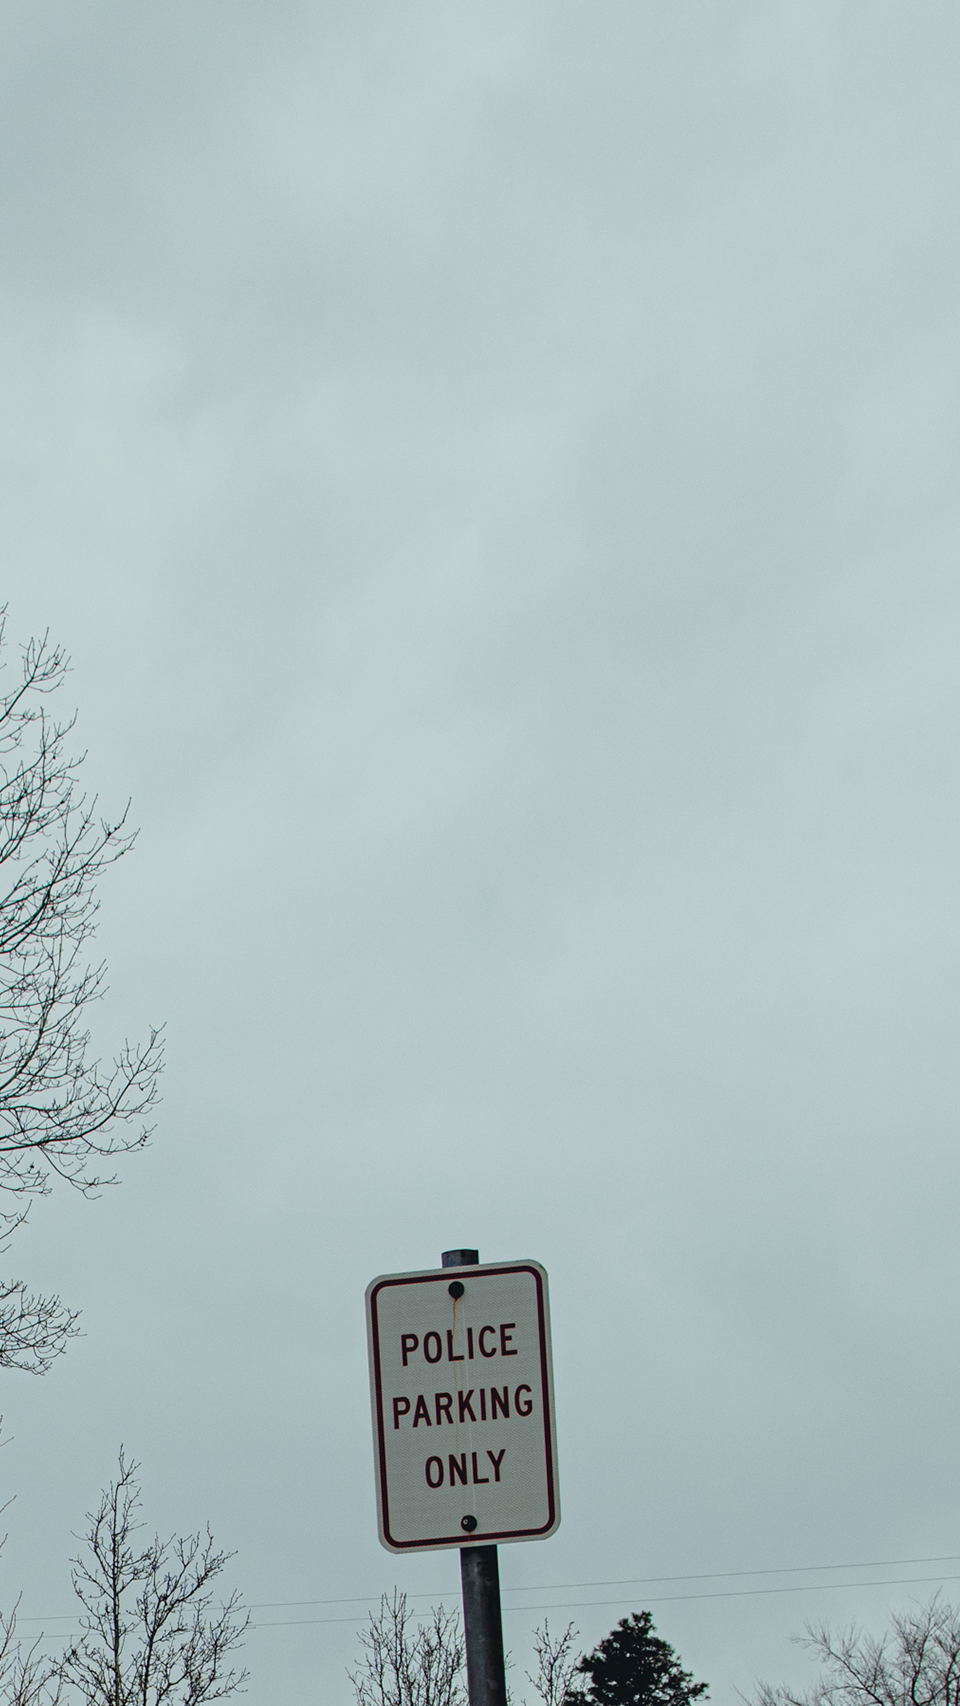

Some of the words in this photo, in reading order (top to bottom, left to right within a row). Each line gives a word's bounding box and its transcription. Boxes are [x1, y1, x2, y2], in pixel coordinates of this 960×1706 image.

[400, 1322, 518, 1366] POLICE
[392, 1384, 533, 1430] PARKING
[424, 1448, 506, 1489] ONLY
